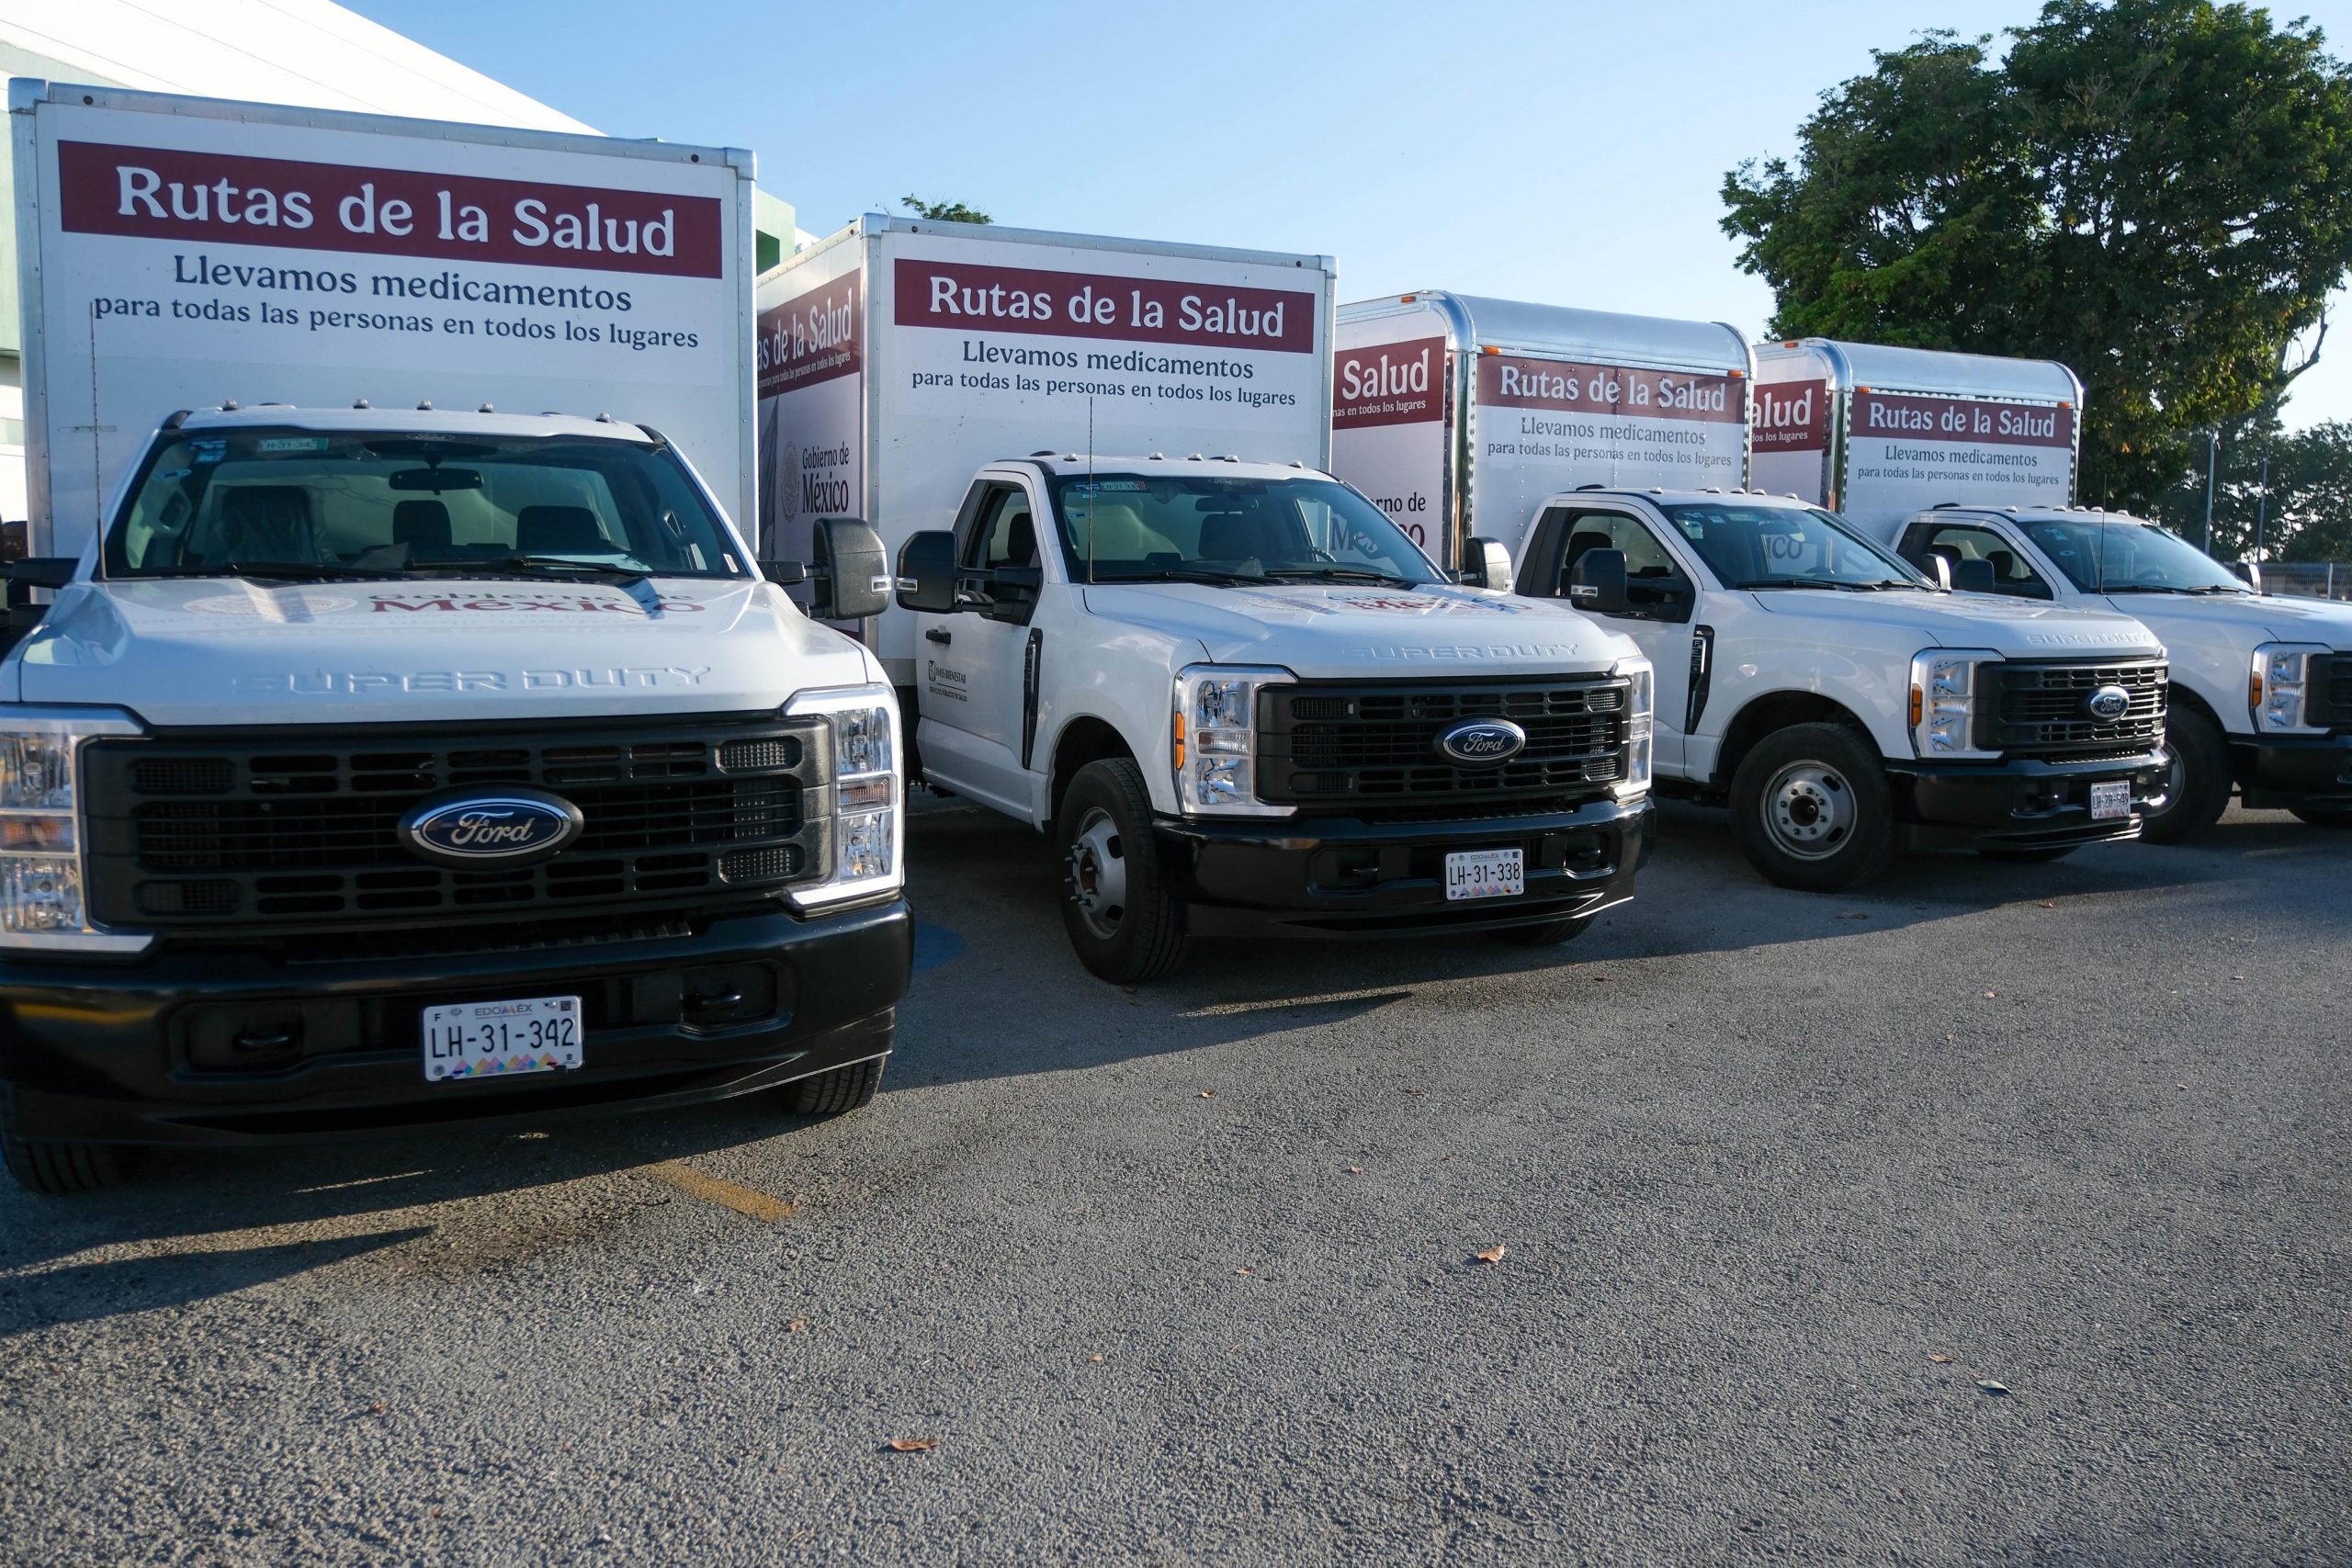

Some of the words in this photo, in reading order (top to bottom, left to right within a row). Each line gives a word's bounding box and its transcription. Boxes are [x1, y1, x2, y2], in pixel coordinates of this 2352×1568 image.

[116, 166, 314, 229] Rutas
[338, 183, 413, 236] de
[436, 190, 489, 243] la
[512, 198, 675, 257] Salud
[175, 254, 357, 294] Llevamos
[371, 271, 633, 312] medicamentos
[929, 276, 1052, 321] Rutas
[1069, 286, 1115, 325] de
[1131, 290, 1164, 328] la
[1179, 296, 1284, 338] Salud
[94, 294, 161, 321] para
[172, 299, 251, 322] todas
[261, 301, 300, 324] las
[310, 308, 434, 332] personas
[443, 317, 474, 335] en
[484, 318, 556, 340] todos
[565, 321, 601, 343] los
[609, 323, 699, 351] lugares
[774, 319, 788, 366] de
[792, 312, 804, 360] la
[809, 287, 853, 353] Salud
[963, 340, 1079, 368] Llevamos
[1087, 350, 1253, 379] medicamentos
[1342, 348, 1429, 400] Salud
[912, 371, 954, 389] para
[960, 372, 1010, 391] todas
[1016, 374, 1040, 392] las
[1046, 378, 1125, 397] personas
[1131, 384, 1151, 398] en
[1158, 382, 1204, 400] todos
[1209, 385, 1232, 402] los
[1238, 387, 1296, 408] lugares
[1500, 366, 1578, 400] Rutas
[1589, 372, 1619, 403] de
[1628, 375, 1649, 405] la
[1658, 378, 1725, 412] Salud
[1347, 407, 1356, 416] en
[1359, 403, 1381, 414] todos
[1383, 401, 1394, 412] los
[1396, 400, 1426, 413] lugares
[1752, 388, 1812, 428] alud
[1869, 402, 1933, 431] Rutas
[1940, 405, 1966, 432] de
[1973, 407, 1991, 434] la
[1998, 410, 2055, 437] Salud
[1521, 417, 1594, 438] Llevamos
[1600, 423, 1705, 445] medicamentos
[1752, 433, 1763, 443] dos
[1765, 432, 1777, 441] los
[1779, 431, 1808, 443] lugares
[802, 446, 838, 469] Gobierno
[840, 441, 849, 465] de
[1488, 443, 1515, 456] para
[1520, 443, 1551, 456] todas
[1555, 444, 1570, 457] las
[1574, 447, 1623, 460] personas
[1627, 451, 1640, 460] en
[1645, 449, 1673, 463] todos
[1677, 451, 1691, 463] los
[1695, 452, 1732, 468] lugares
[1885, 445, 1945, 463] Llevamos
[1949, 449, 2038, 467] medicamentos
[1858, 468, 1880, 479] para
[1883, 467, 1908, 478] todas
[1912, 468, 1925, 478] las
[1928, 470, 1969, 481] personas
[1972, 472, 1983, 481] en
[1986, 471, 2010, 482] todos
[2013, 472, 2025, 482] los
[2028, 473, 2058, 486] lugares
[802, 470, 849, 513] México
[1408, 491, 1426, 512] de
[369, 599, 707, 615] México
[1342, 645, 1483, 660] SUPER
[1487, 643, 1578, 659] DUTY
[232, 671, 507, 694] SUPER
[523, 666, 711, 690] DUTY
[2100, 696, 2122, 712] Ford
[1463, 732, 1506, 753] Ford
[450, 811, 537, 845] Ford
[1450, 863, 1521, 886] LH-31-338
[435, 1013, 441, 1021] F
[432, 1018, 575, 1058] LH-31-342
